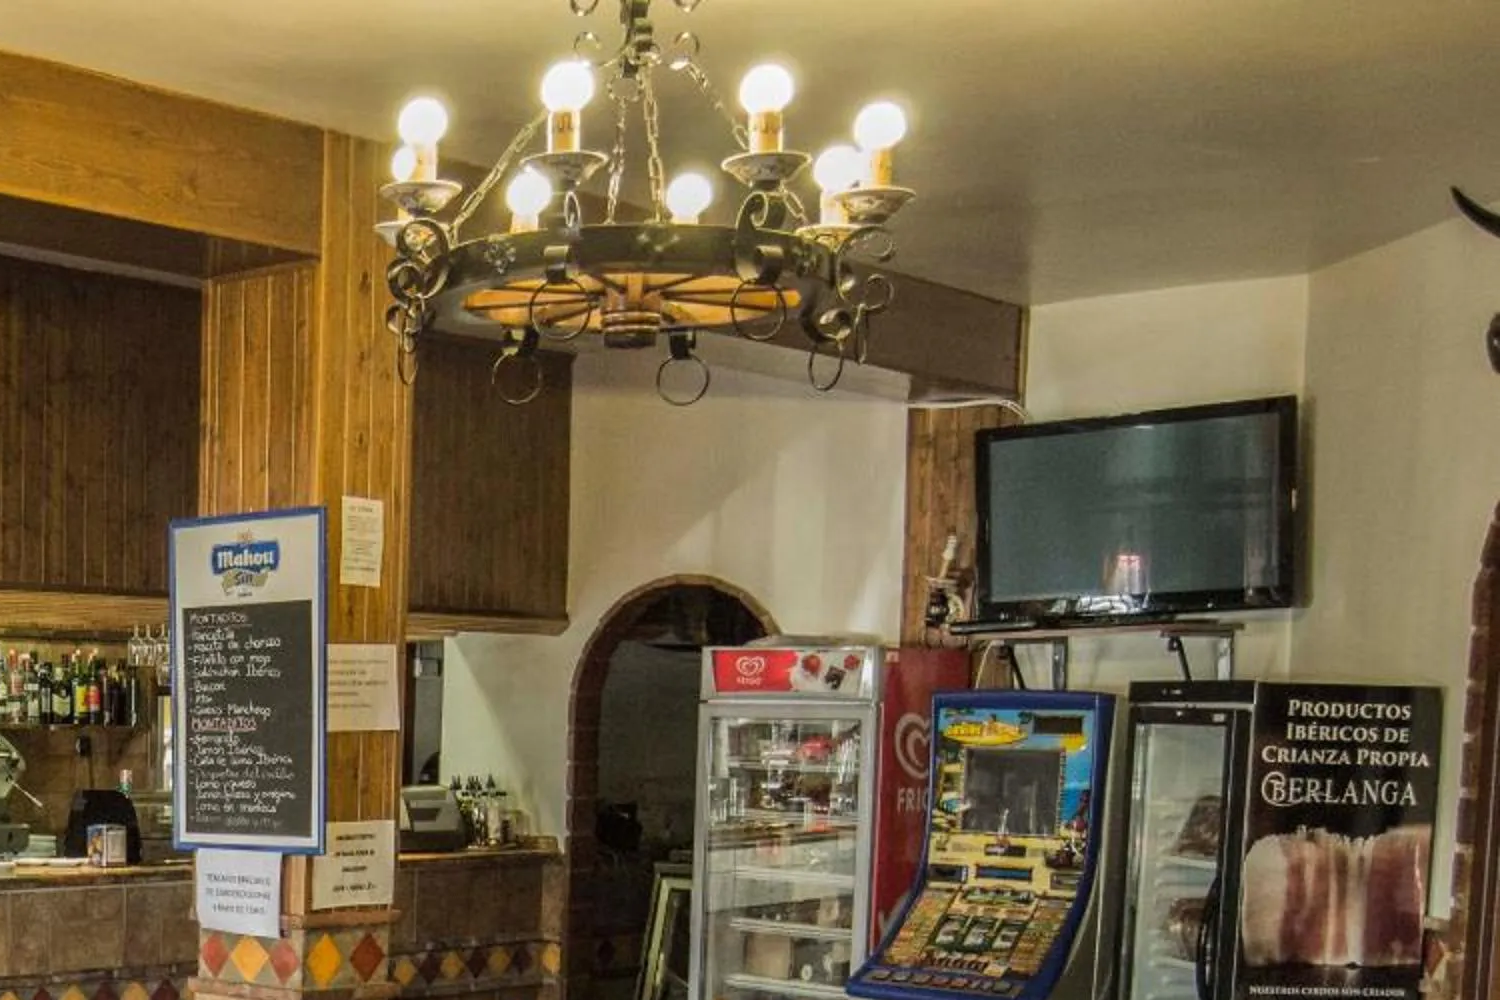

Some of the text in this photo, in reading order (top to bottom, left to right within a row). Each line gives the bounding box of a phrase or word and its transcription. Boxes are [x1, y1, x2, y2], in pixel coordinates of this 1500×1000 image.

[216, 549, 275, 569] Mahou
[1287, 699, 1412, 720] PRODUCTOS
[1286, 721, 1411, 743] IBÉRICOS DE
[1261, 745, 1430, 768] CRIANZA PROPIA
[1261, 771, 1418, 807] BERLANGA
